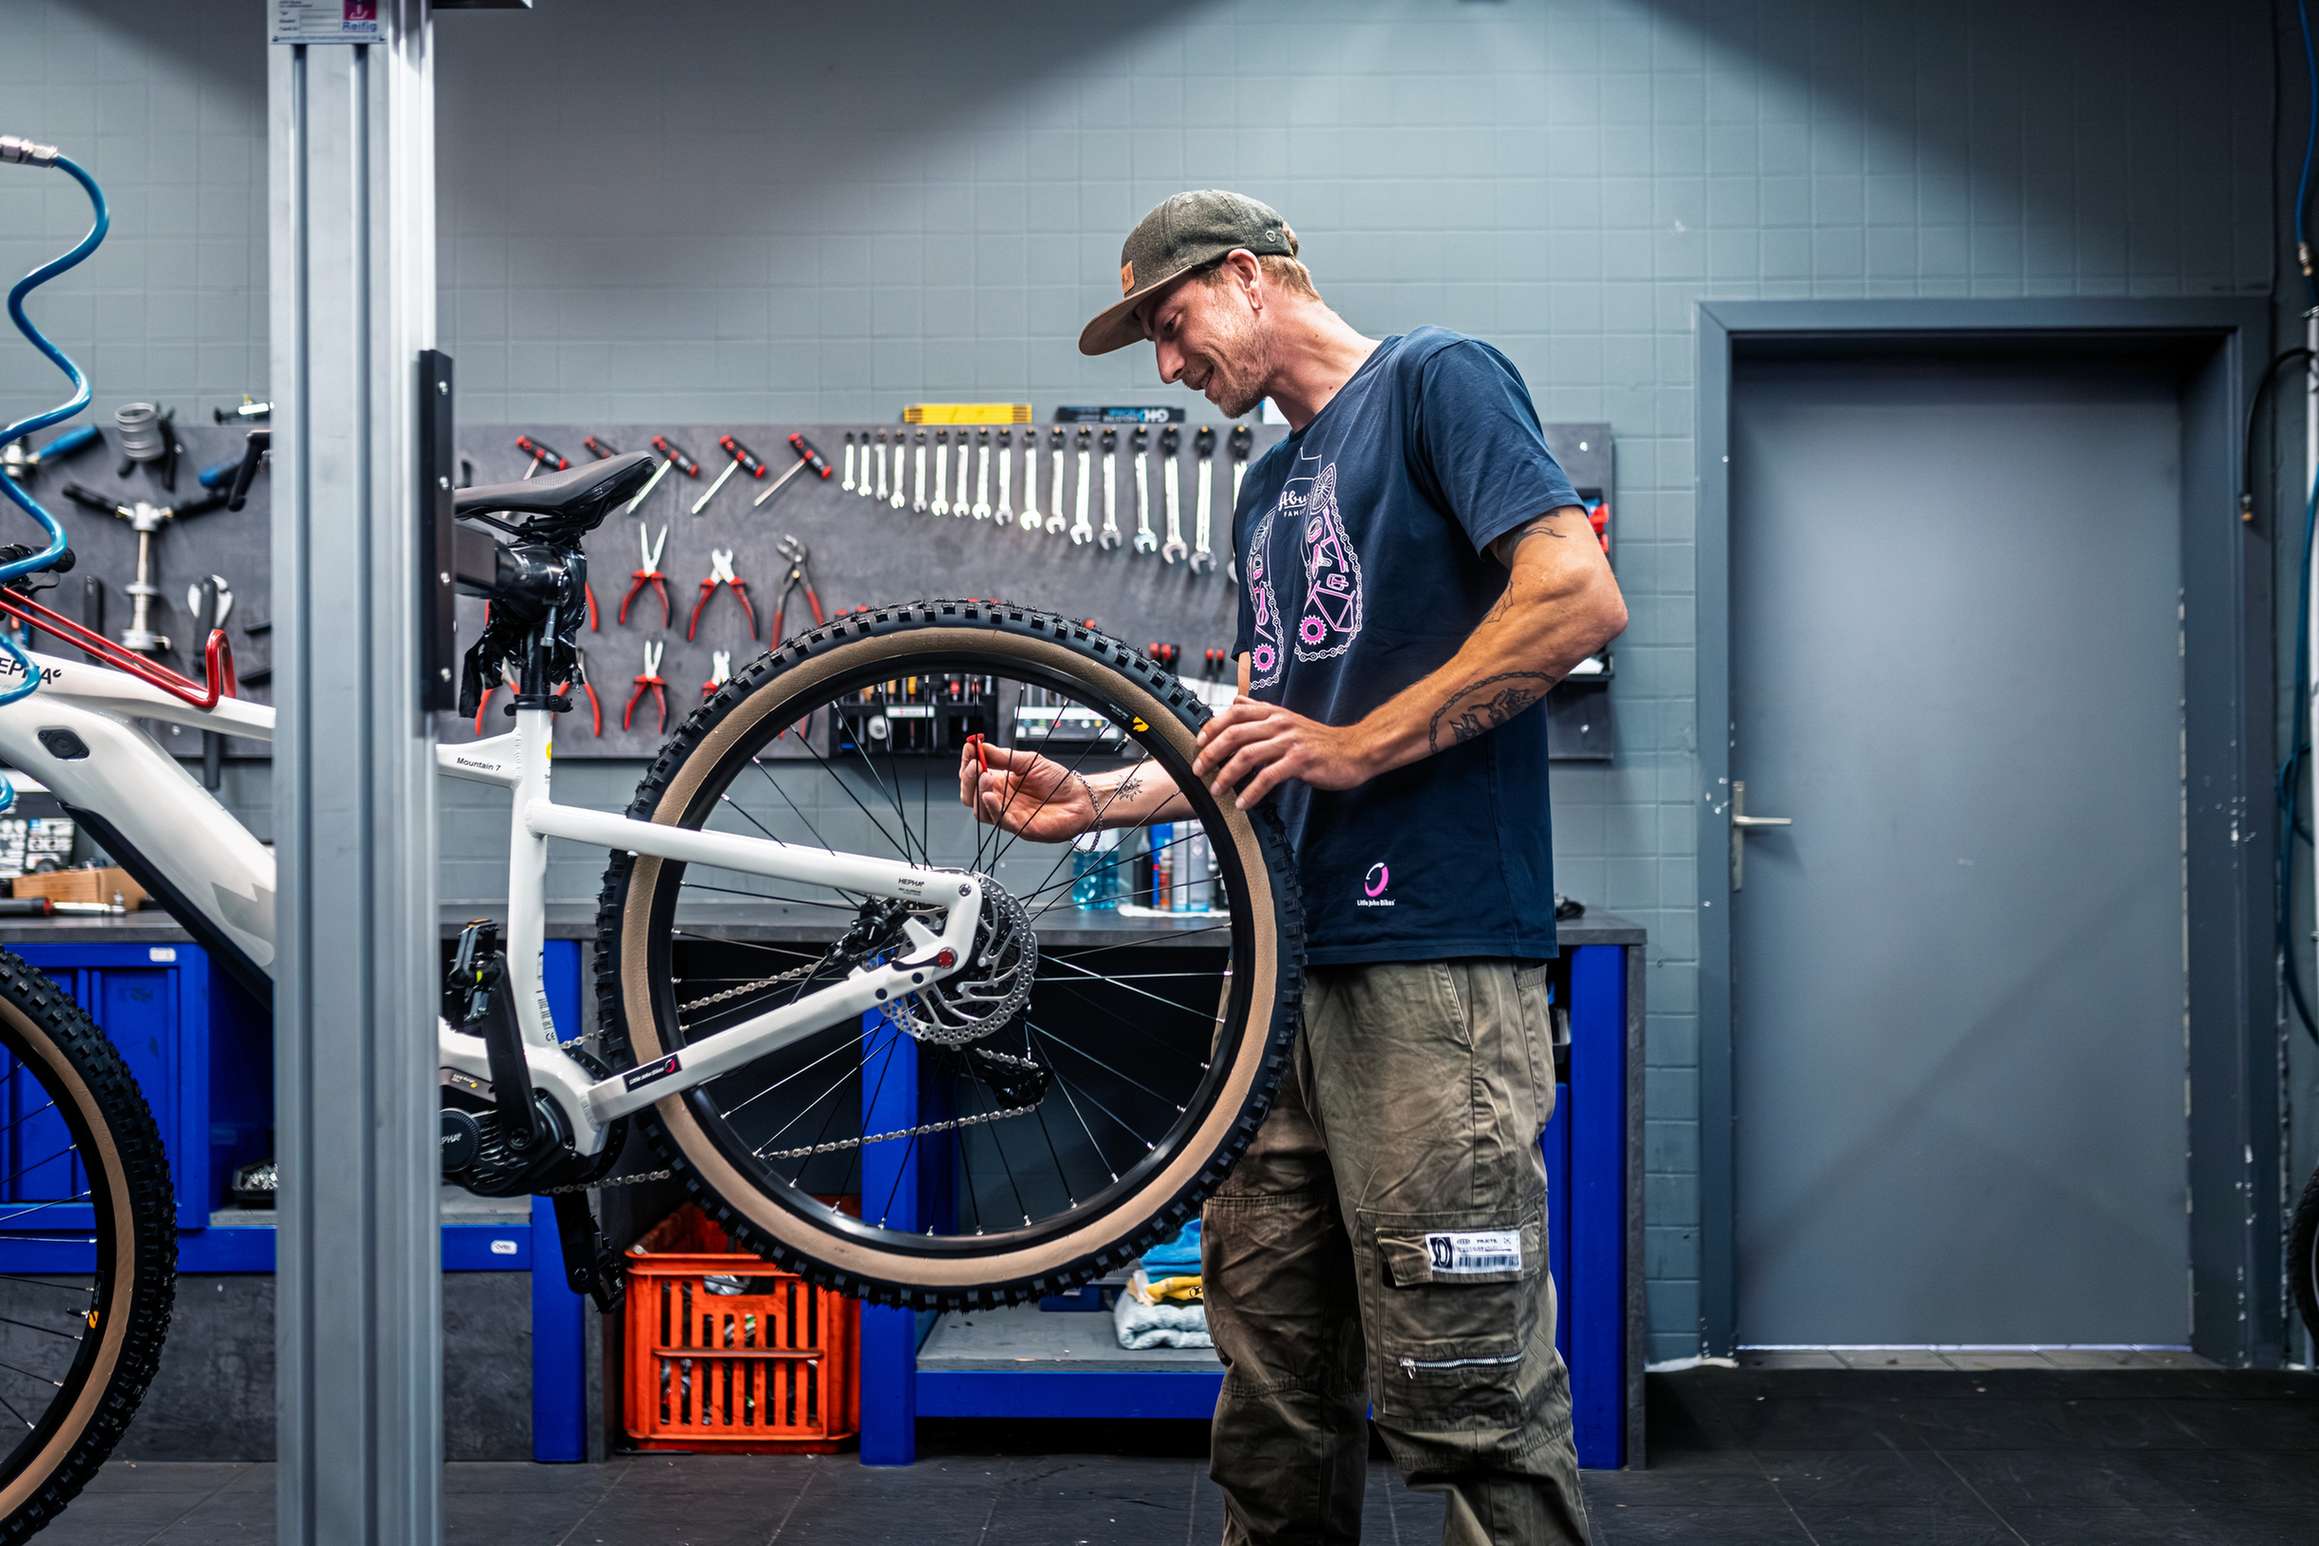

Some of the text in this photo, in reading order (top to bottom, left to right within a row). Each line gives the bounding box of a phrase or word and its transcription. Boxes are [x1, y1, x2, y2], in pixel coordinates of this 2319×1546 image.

[342, 21, 377, 32] Reifig
[456, 757, 502, 772] Mountain 7
[1368, 899, 1380, 908] John
